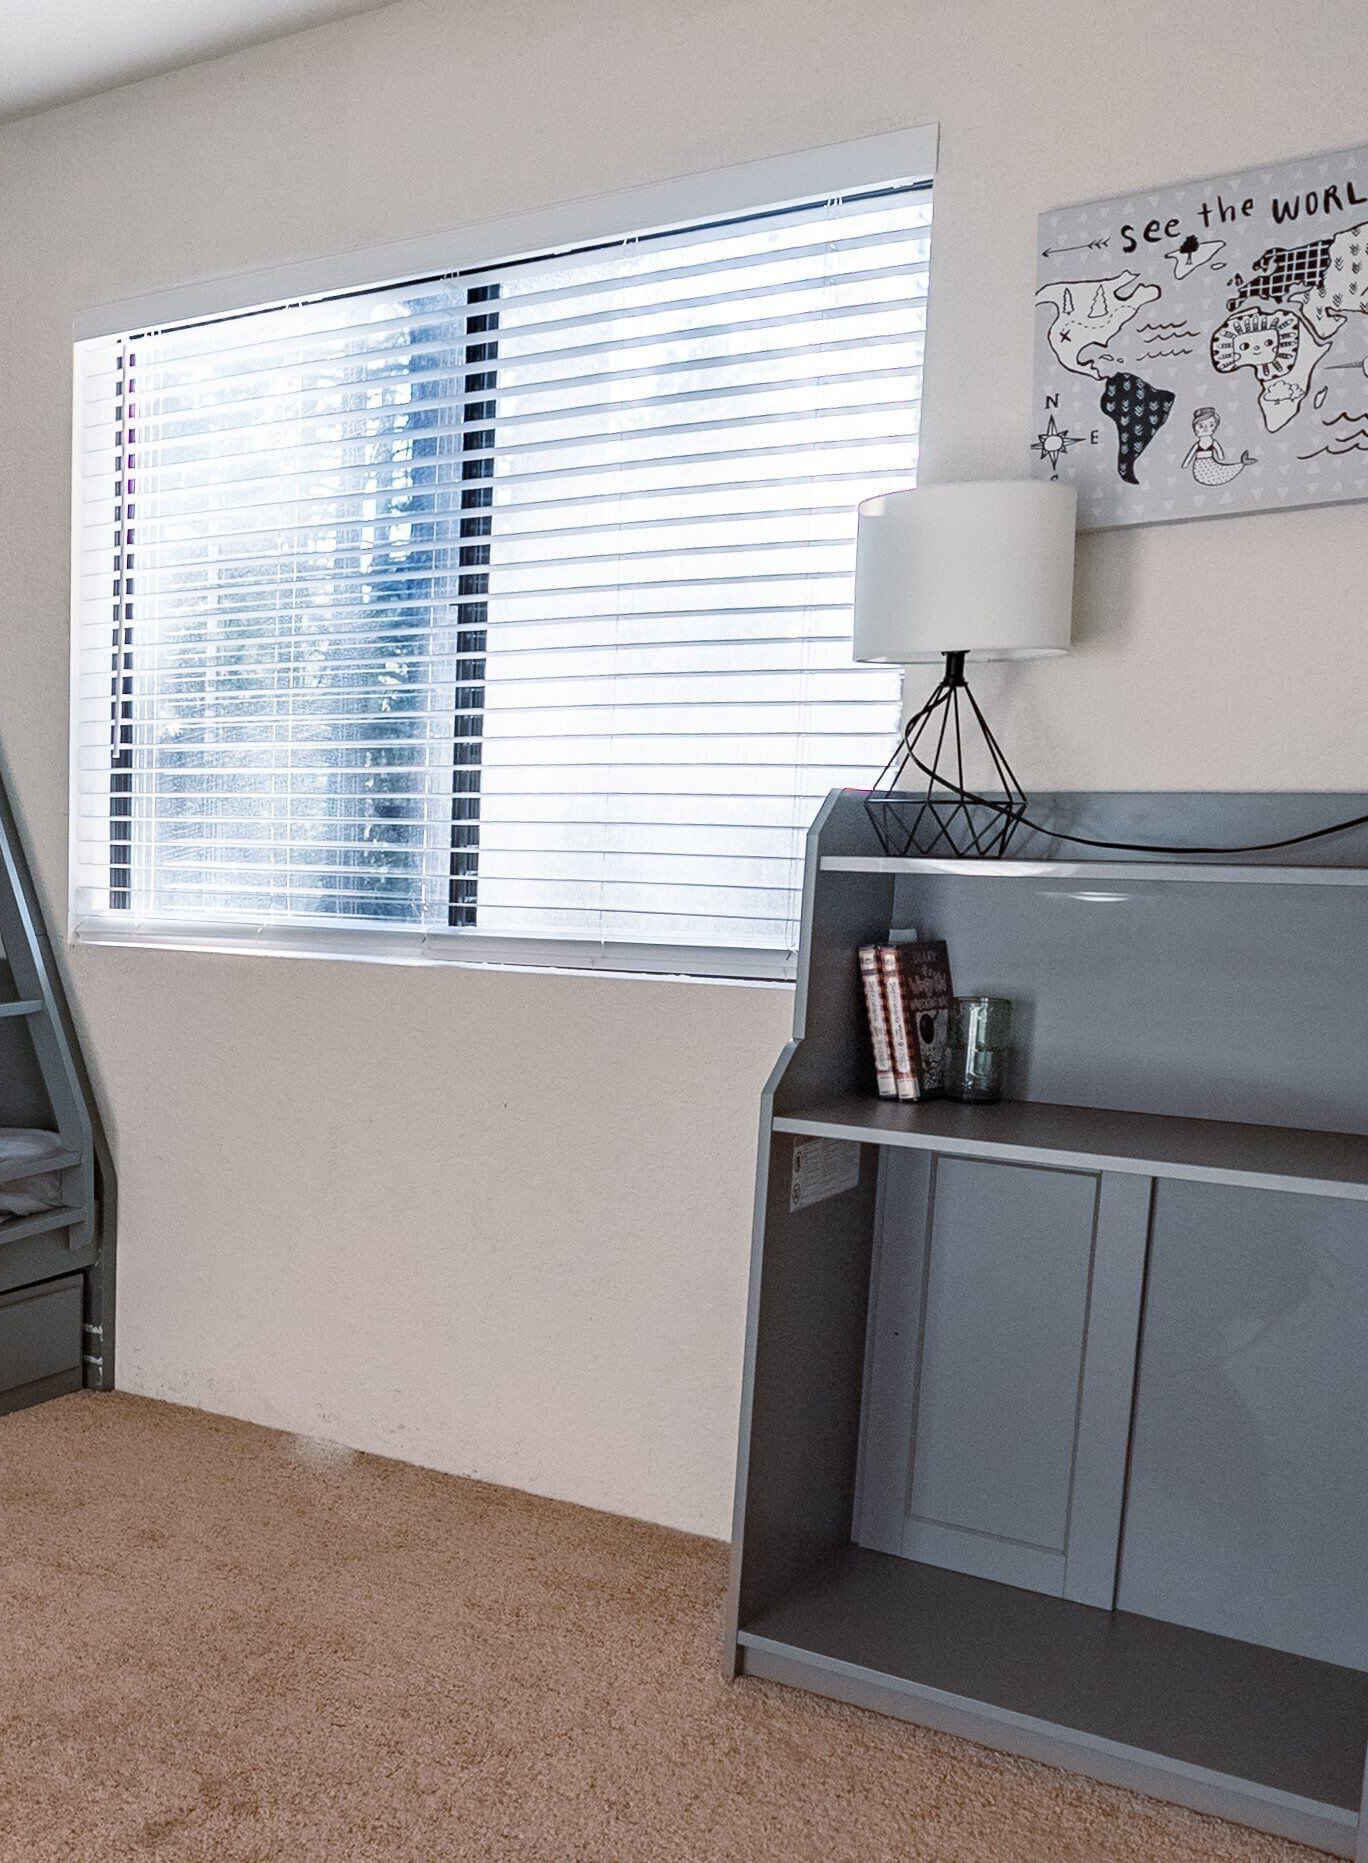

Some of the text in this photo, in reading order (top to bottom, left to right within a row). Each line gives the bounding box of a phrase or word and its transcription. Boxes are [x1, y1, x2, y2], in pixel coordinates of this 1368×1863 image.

[1197, 195, 1254, 228] the
[1044, 392, 1060, 410] N
[1090, 429, 1099, 445] E
